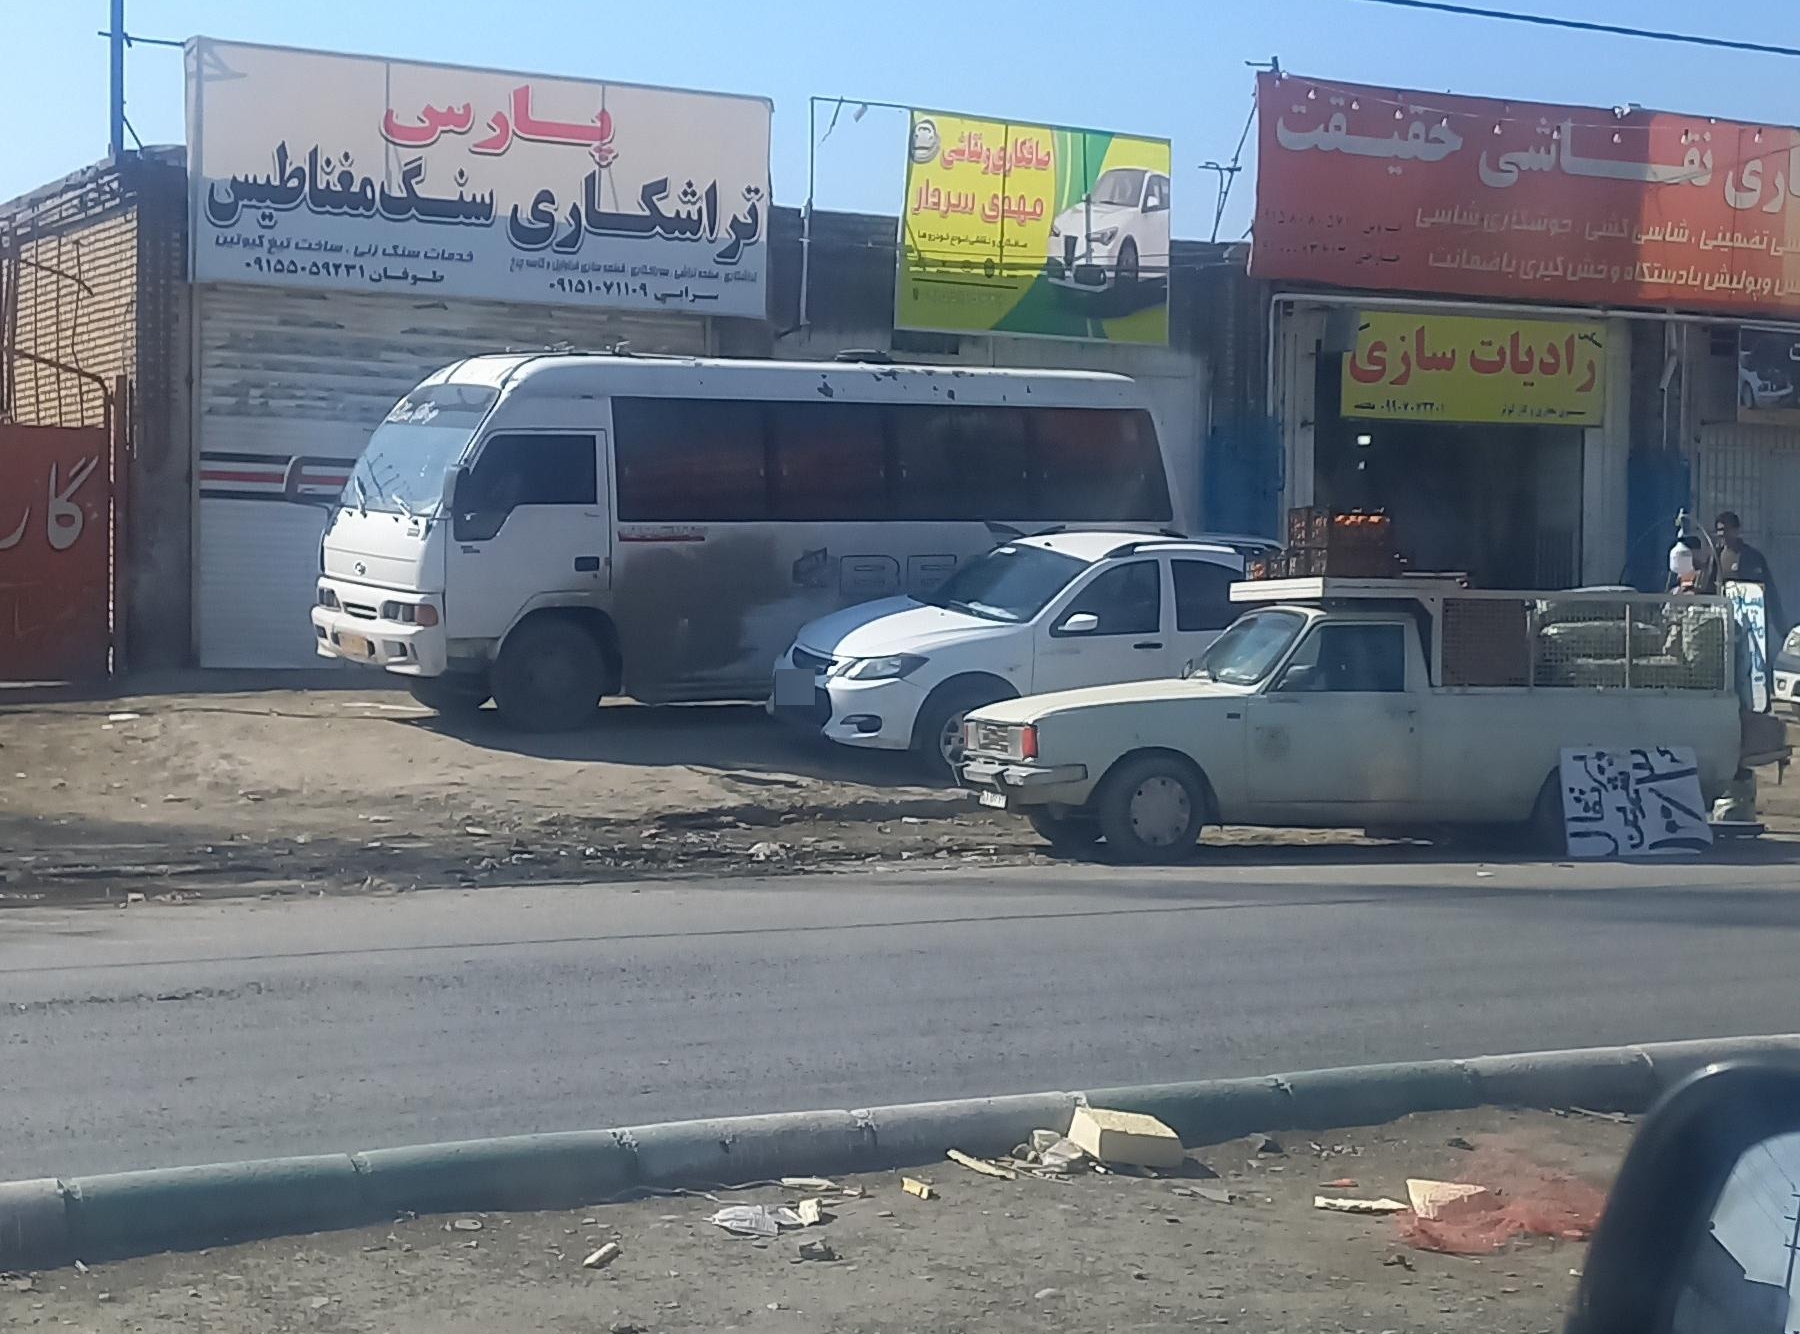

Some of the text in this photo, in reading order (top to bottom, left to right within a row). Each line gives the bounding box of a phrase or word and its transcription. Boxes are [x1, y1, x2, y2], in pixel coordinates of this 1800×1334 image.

[381, 84, 616, 165] پارس
[1276, 95, 1464, 176] حقیقت
[990, 137, 1052, 176] صافکاری
[1479, 117, 1713, 188] نقاشی
[206, 141, 761, 264] تراشکاری سنگ مغناطیس
[912, 178, 1045, 226] مهدی سردار
[1415, 201, 1481, 228] شاسی
[267, 237, 292, 255] تیغ
[295, 238, 343, 254] ساخت
[1632, 219, 1690, 245] شاسی
[1700, 225, 1770, 252] تضمینی
[245, 255, 445, 285] طوفان ۰۹۱۵۵۰۵۹۲۳۱
[424, 247, 474, 263] خدمات
[549, 277, 648, 298] ۰۹۱۵۱۰۷۱۱۰۹
[1348, 326, 1597, 393] رادیات سازی
